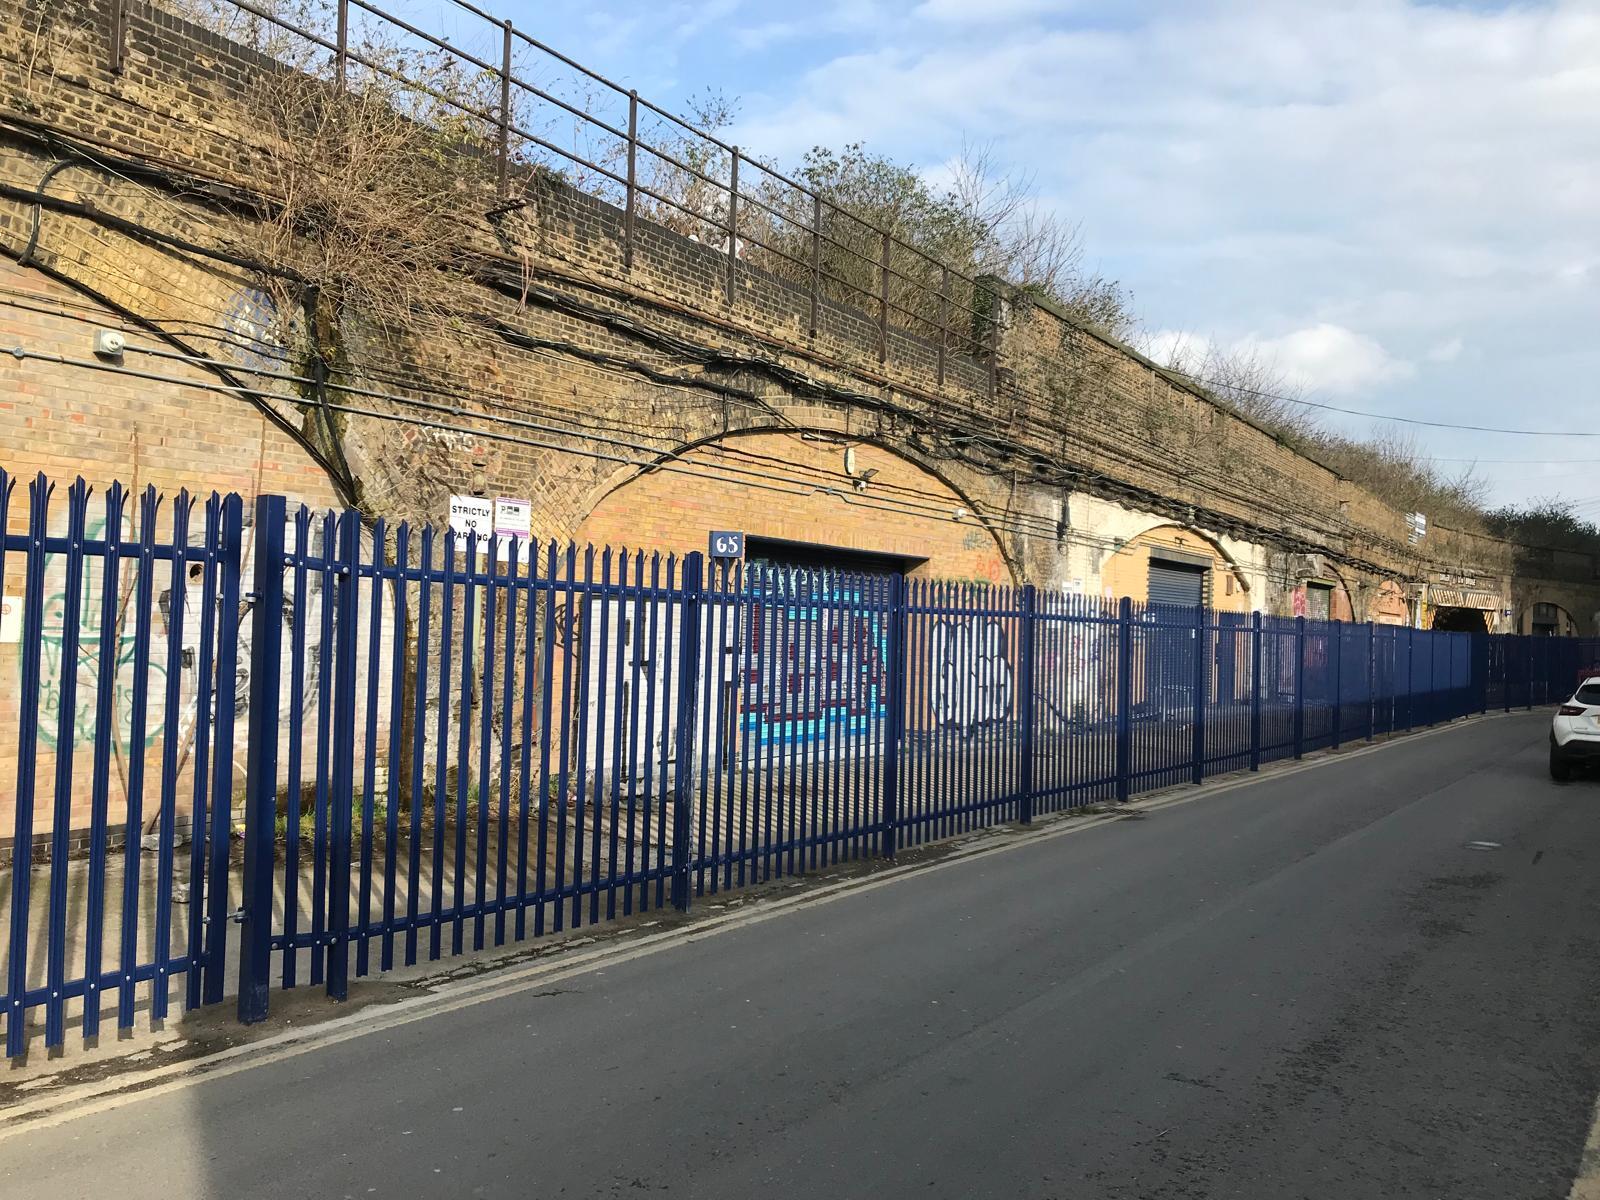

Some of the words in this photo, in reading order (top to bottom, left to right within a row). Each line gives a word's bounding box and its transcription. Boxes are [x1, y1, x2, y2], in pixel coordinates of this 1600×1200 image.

[452, 505, 490, 517] STRICTLY
[465, 519, 477, 528] NO
[716, 535, 739, 554] 65
